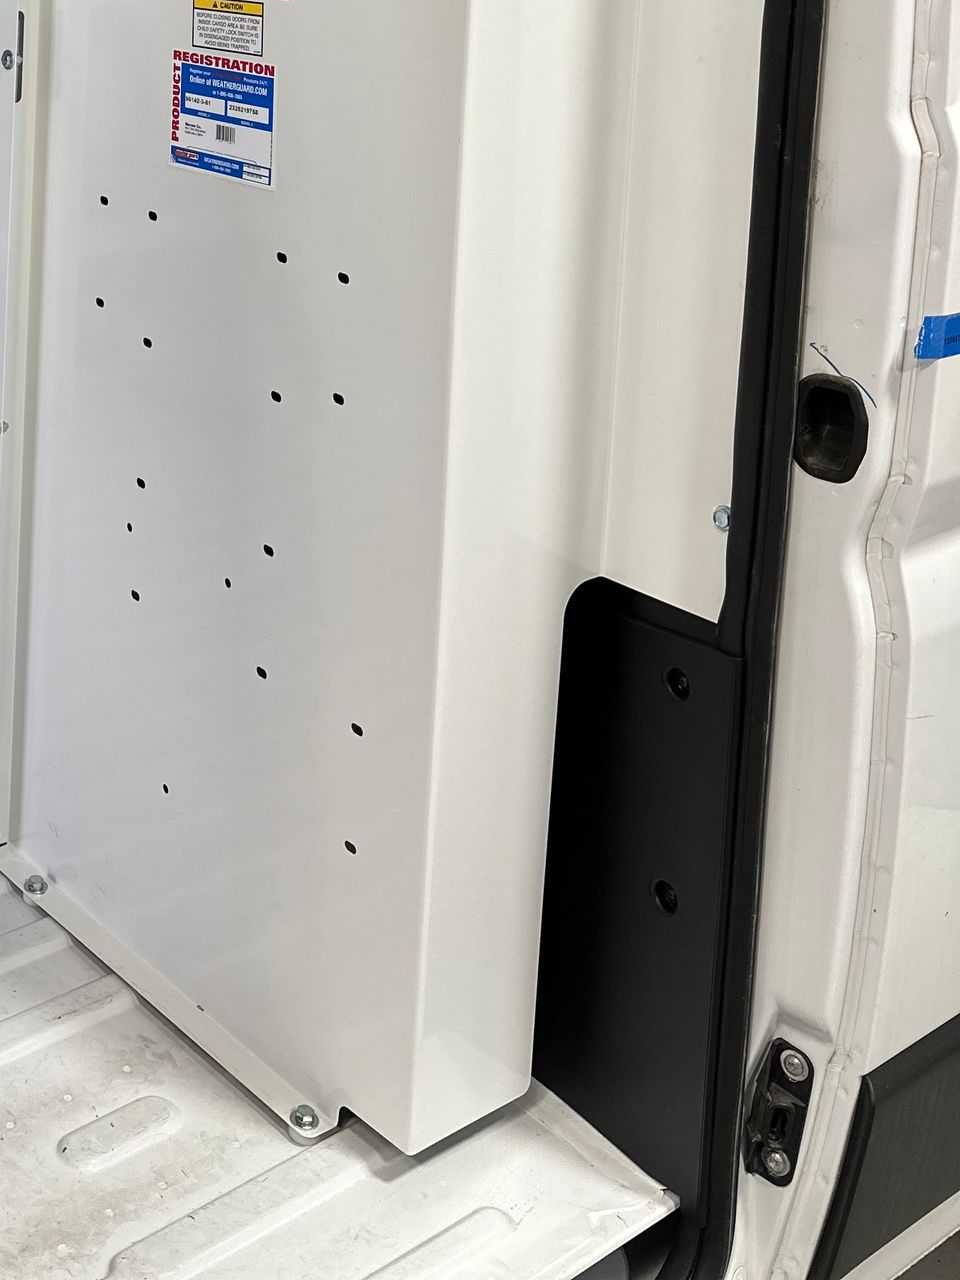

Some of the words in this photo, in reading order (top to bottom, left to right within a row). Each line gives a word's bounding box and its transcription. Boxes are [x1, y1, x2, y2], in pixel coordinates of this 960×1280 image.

[220, 2, 244, 11] CAUTION
[212, 20, 227, 28] CARGO
[204, 33, 230, 42] DISENGAGED
[230, 36, 250, 45] POSITION
[173, 50, 275, 76] REGISTRATION
[189, 74, 206, 85] Online
[212, 79, 268, 97] WEATHERGUARD.COM
[171, 63, 181, 142] PRODUCT
